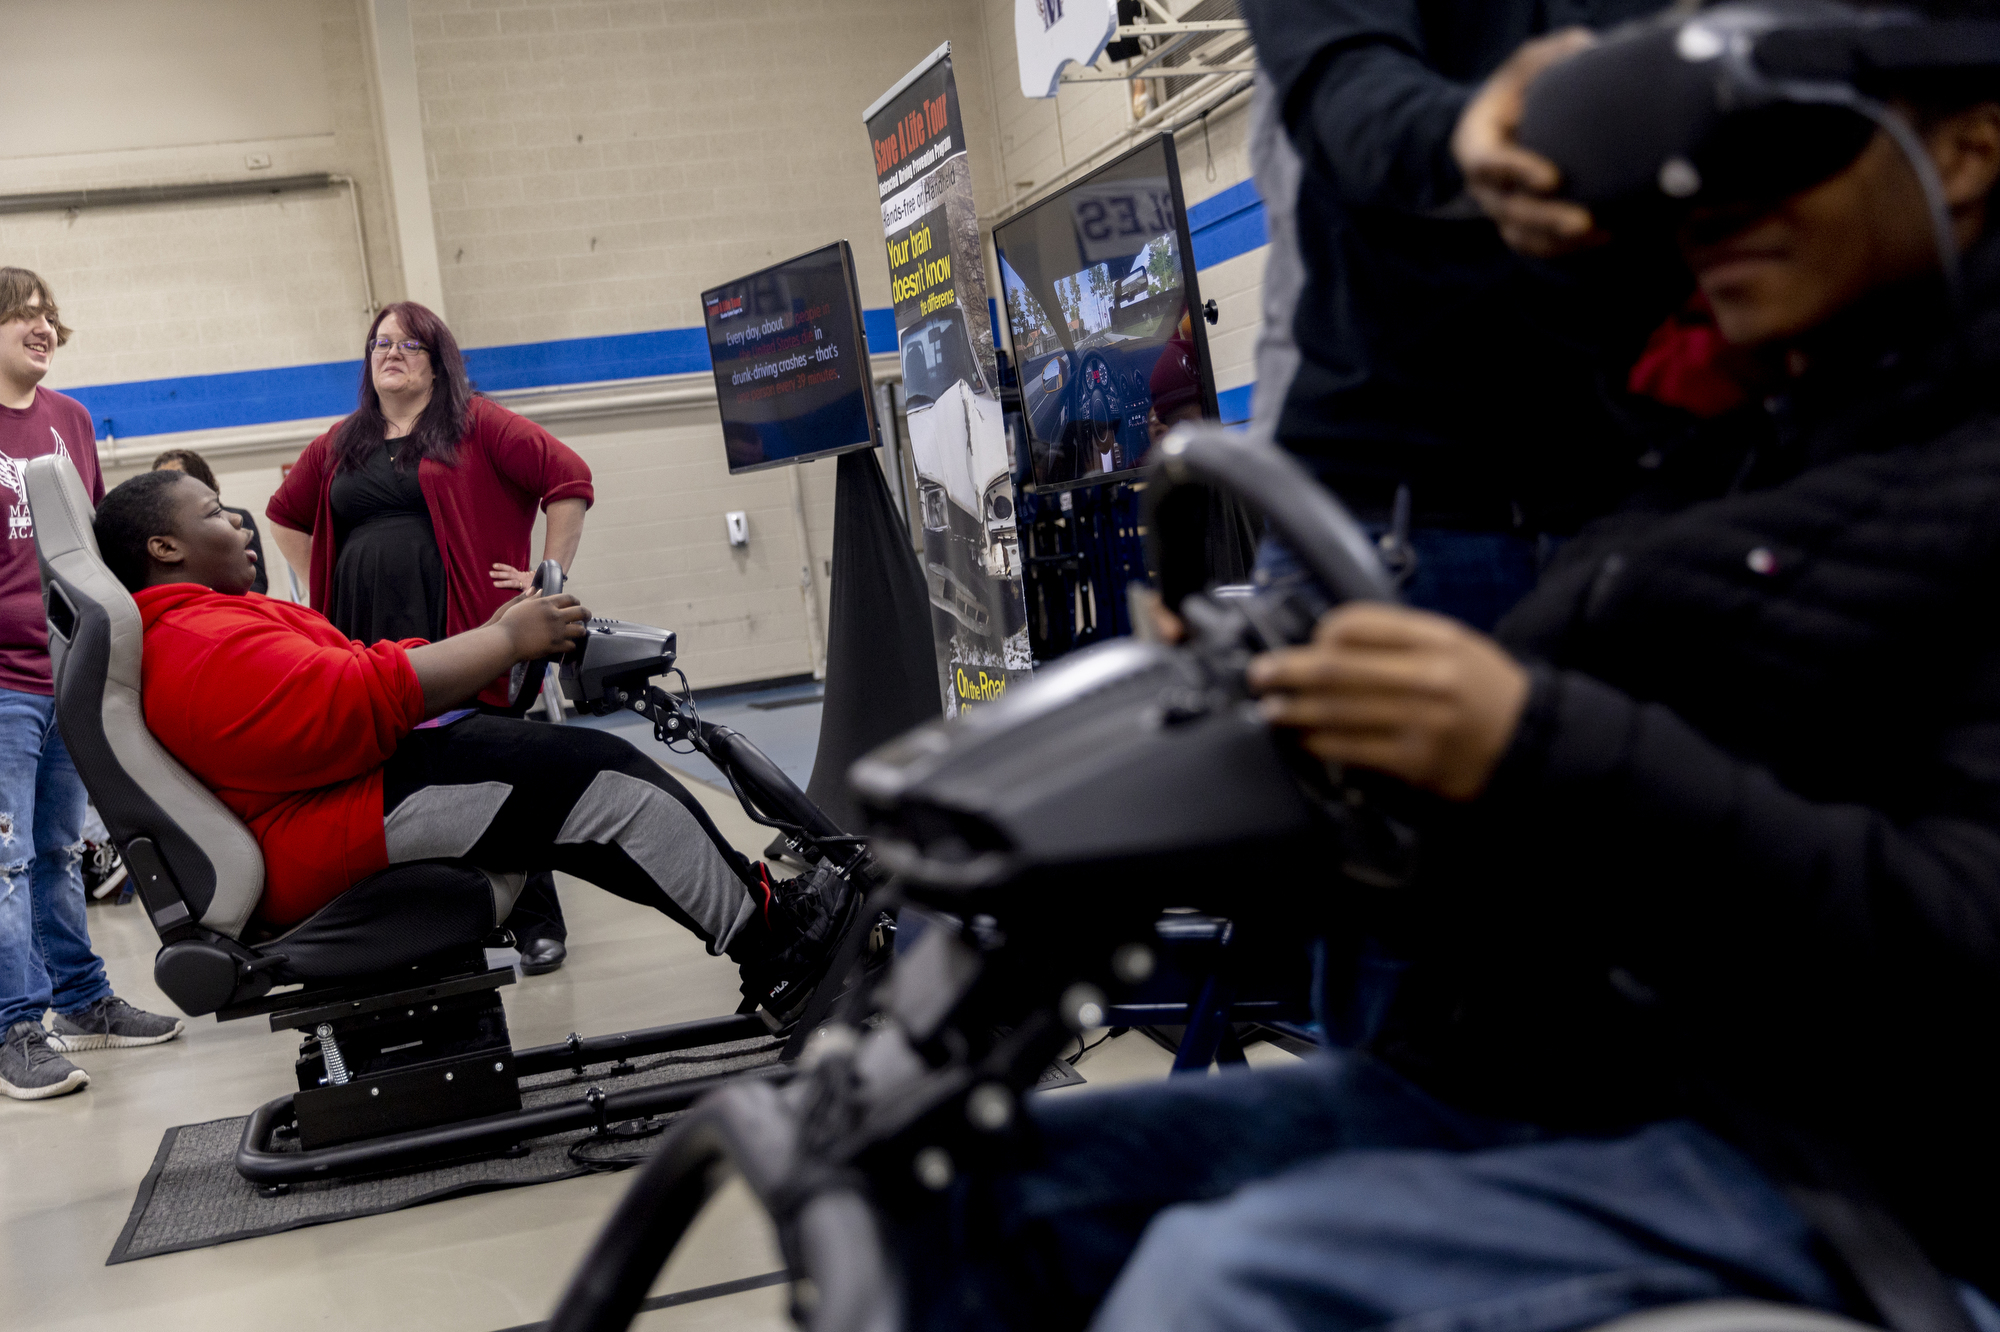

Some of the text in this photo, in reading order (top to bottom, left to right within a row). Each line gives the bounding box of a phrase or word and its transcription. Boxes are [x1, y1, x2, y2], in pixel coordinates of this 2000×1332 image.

[875, 92, 948, 176] Save A Life Tour
[887, 222, 932, 270] Your brain
[924, 254, 951, 288] know
[927, 288, 955, 313] difference
[726, 331, 745, 346] Every
[745, 325, 761, 341] day,
[762, 316, 784, 335] about
[814, 325, 823, 340] in
[732, 362, 778, 385] drunk-driving
[779, 353, 807, 372] crashes
[815, 343, 839, 362] that's
[957, 668, 1007, 702] On the Road
[768, 980, 789, 998] FILA
